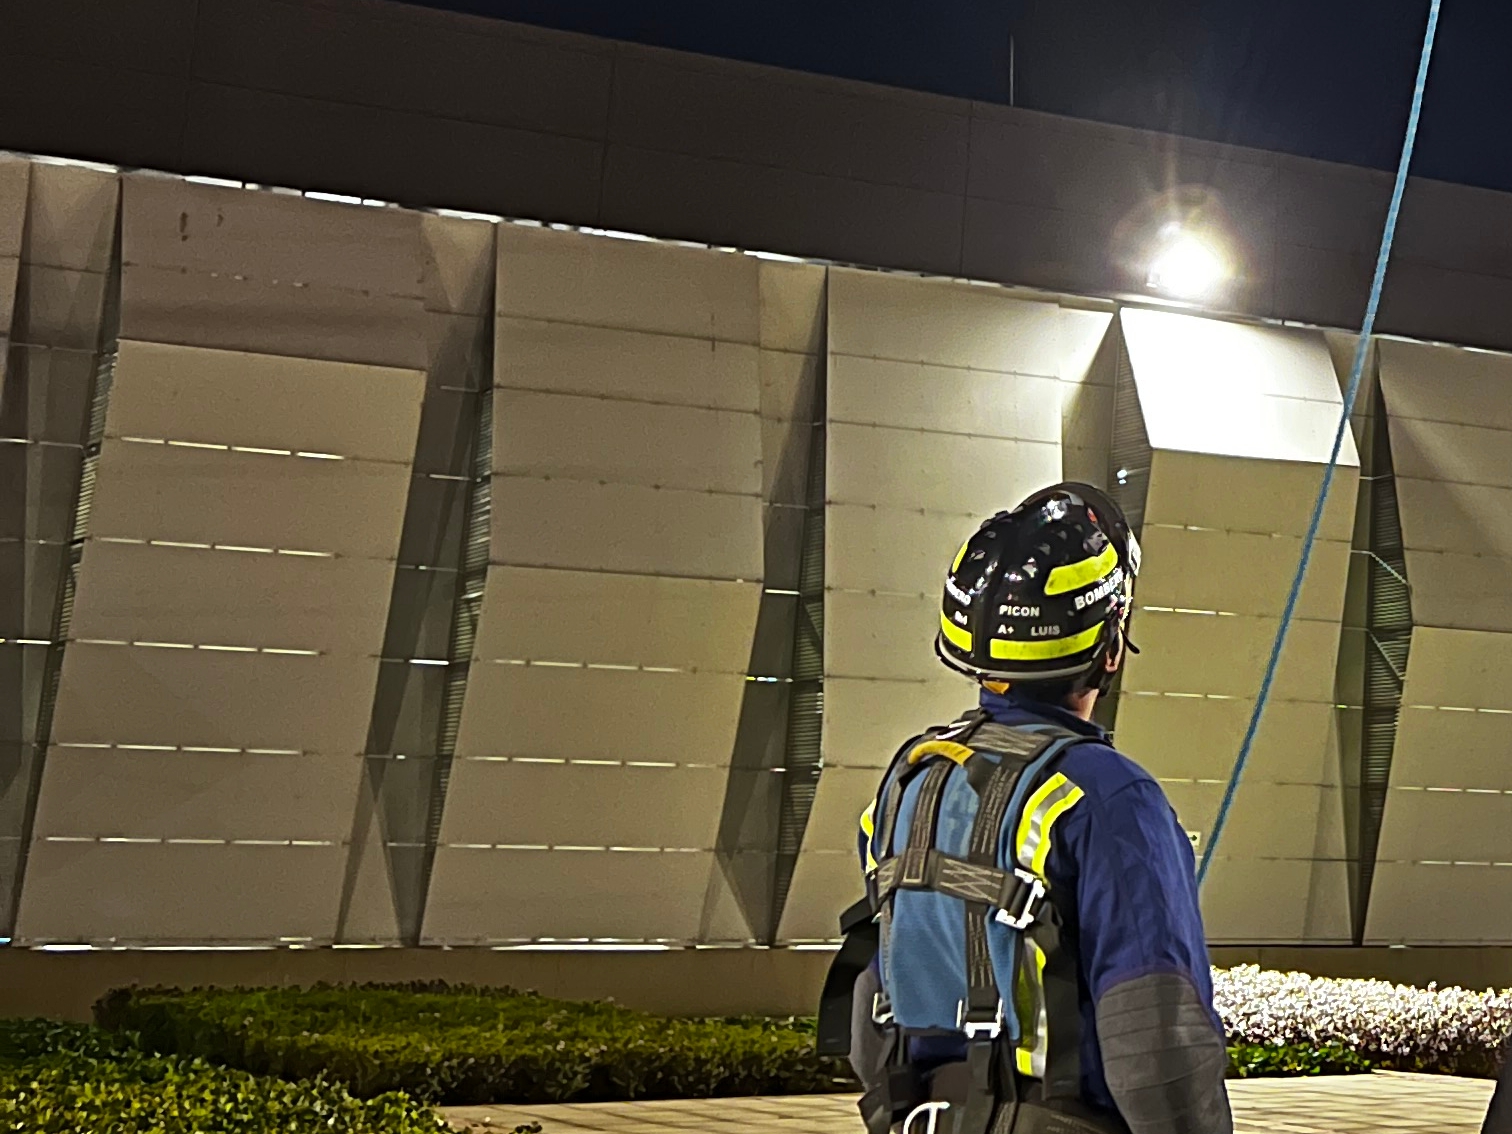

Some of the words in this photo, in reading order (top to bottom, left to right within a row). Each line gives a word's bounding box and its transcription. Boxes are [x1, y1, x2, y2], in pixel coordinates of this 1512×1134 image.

[1074, 566, 1124, 610] BOMBER
[998, 604, 1041, 618] PICON
[997, 624, 1015, 634] A+
[1030, 624, 1061, 636] LUIS
